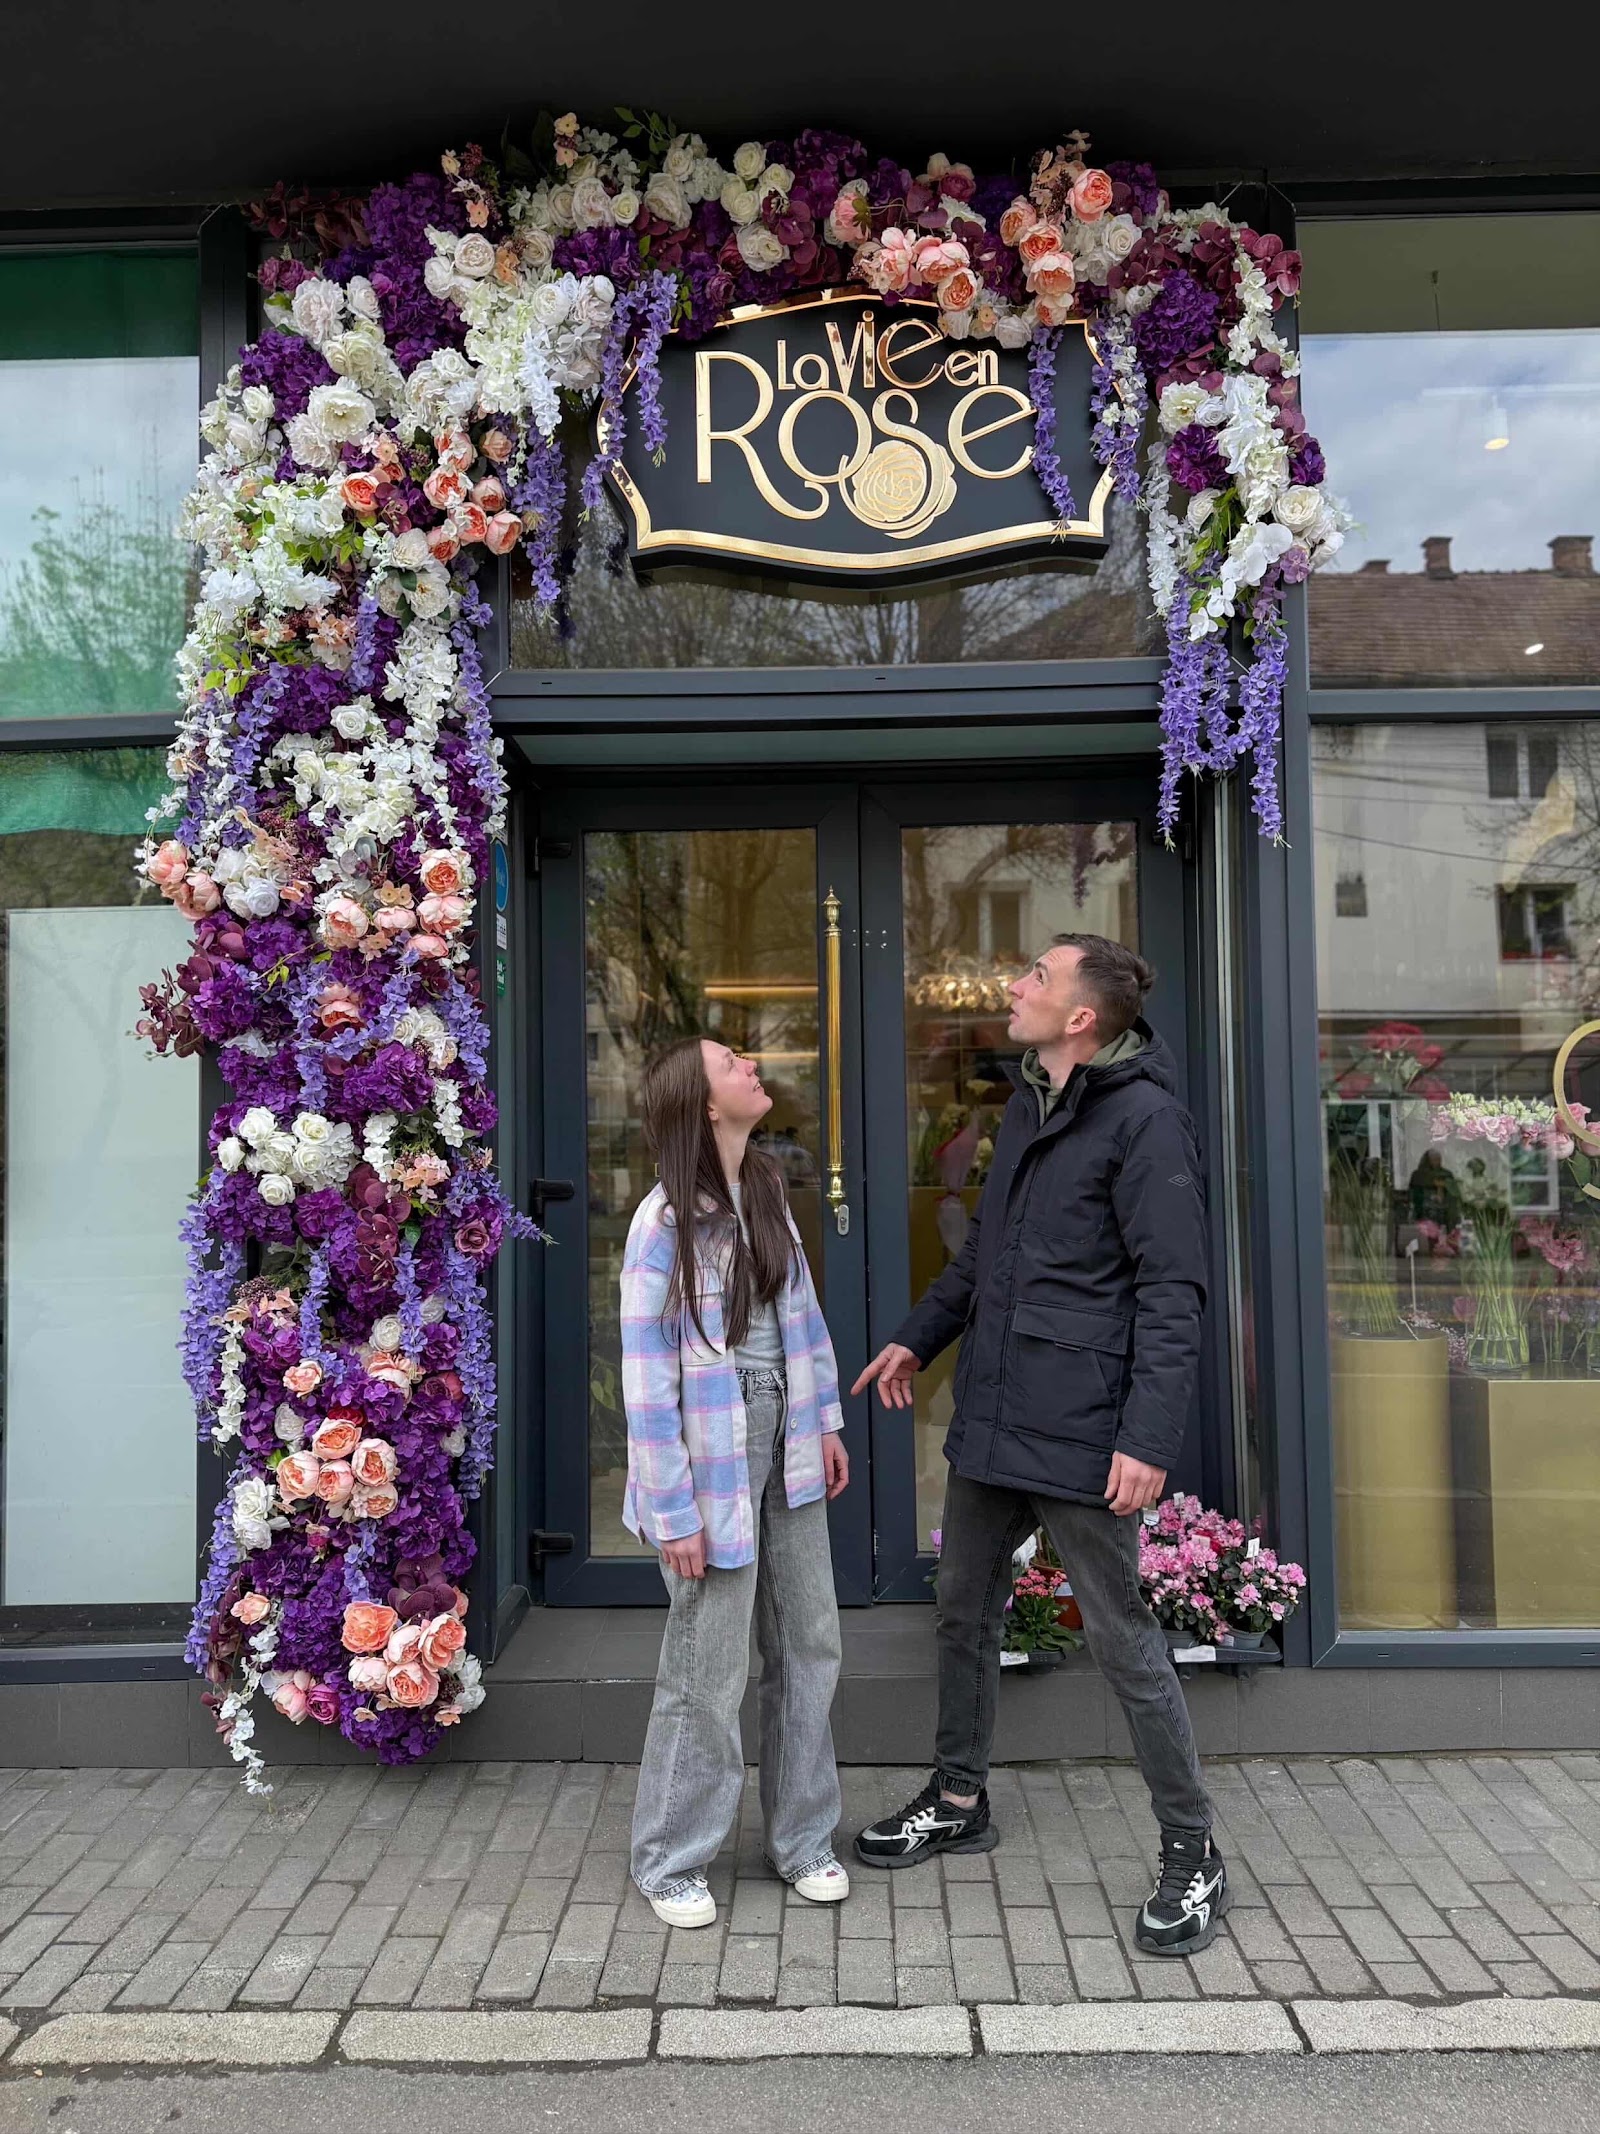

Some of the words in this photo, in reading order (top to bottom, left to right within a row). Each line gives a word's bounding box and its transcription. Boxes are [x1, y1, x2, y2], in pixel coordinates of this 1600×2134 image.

[776, 339, 830, 391] La
[825, 310, 944, 394] Vie
[944, 348, 1000, 386] en
[695, 350, 1038, 532] Rose
